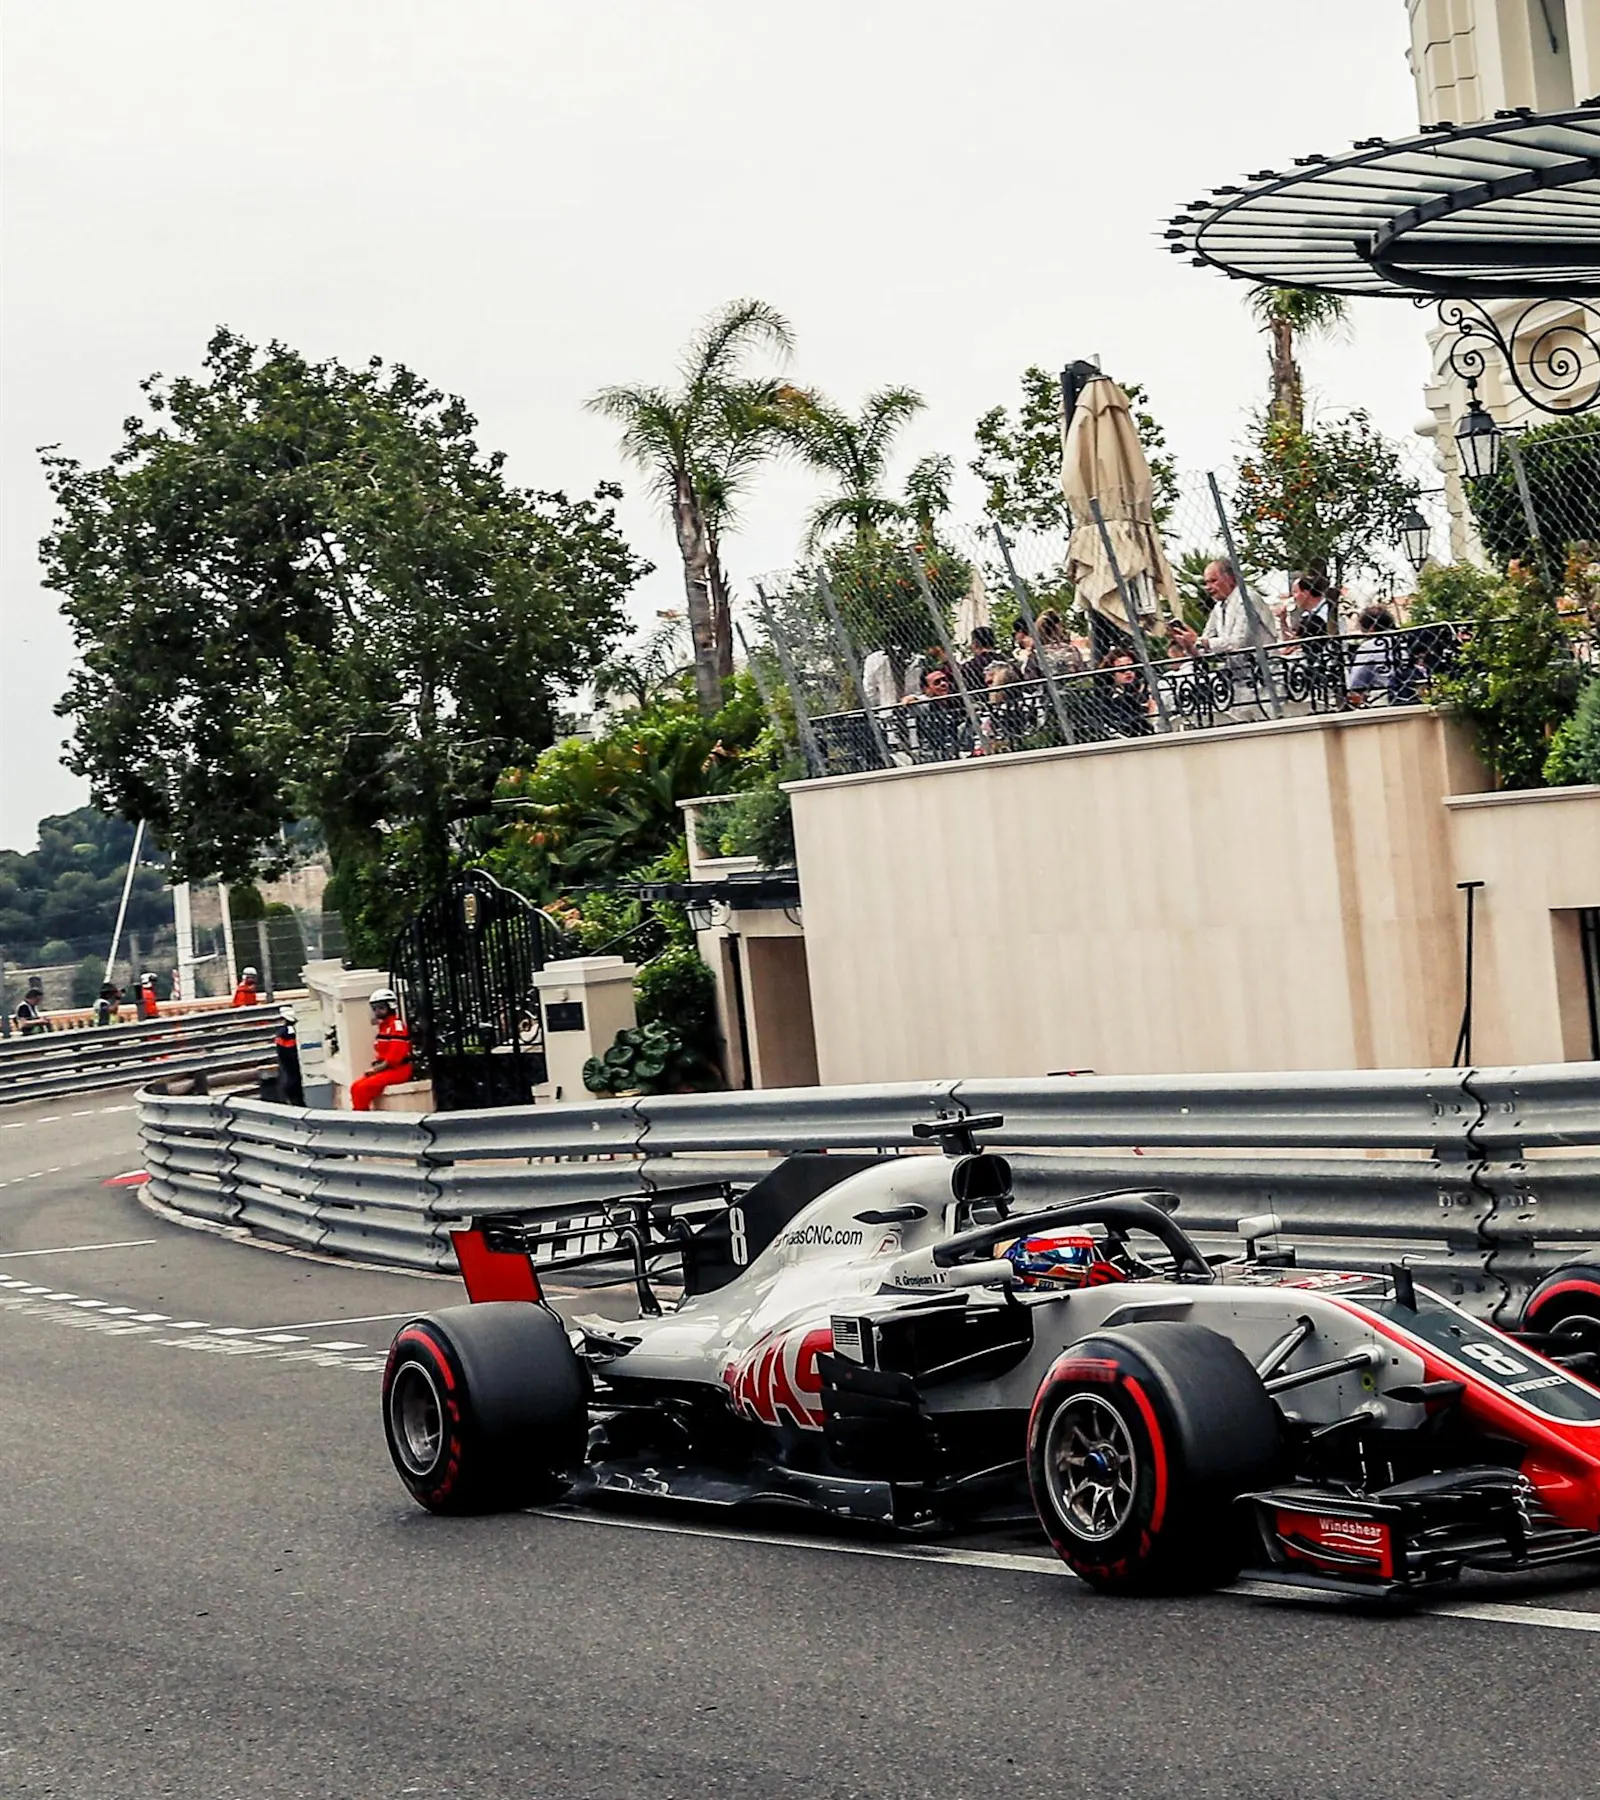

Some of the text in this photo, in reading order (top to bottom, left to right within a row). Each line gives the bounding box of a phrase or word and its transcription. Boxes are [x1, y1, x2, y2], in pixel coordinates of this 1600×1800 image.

[729, 1207, 749, 1265] 8
[1461, 1343, 1529, 1376] 8
[1319, 1518, 1381, 1537] Windshear
